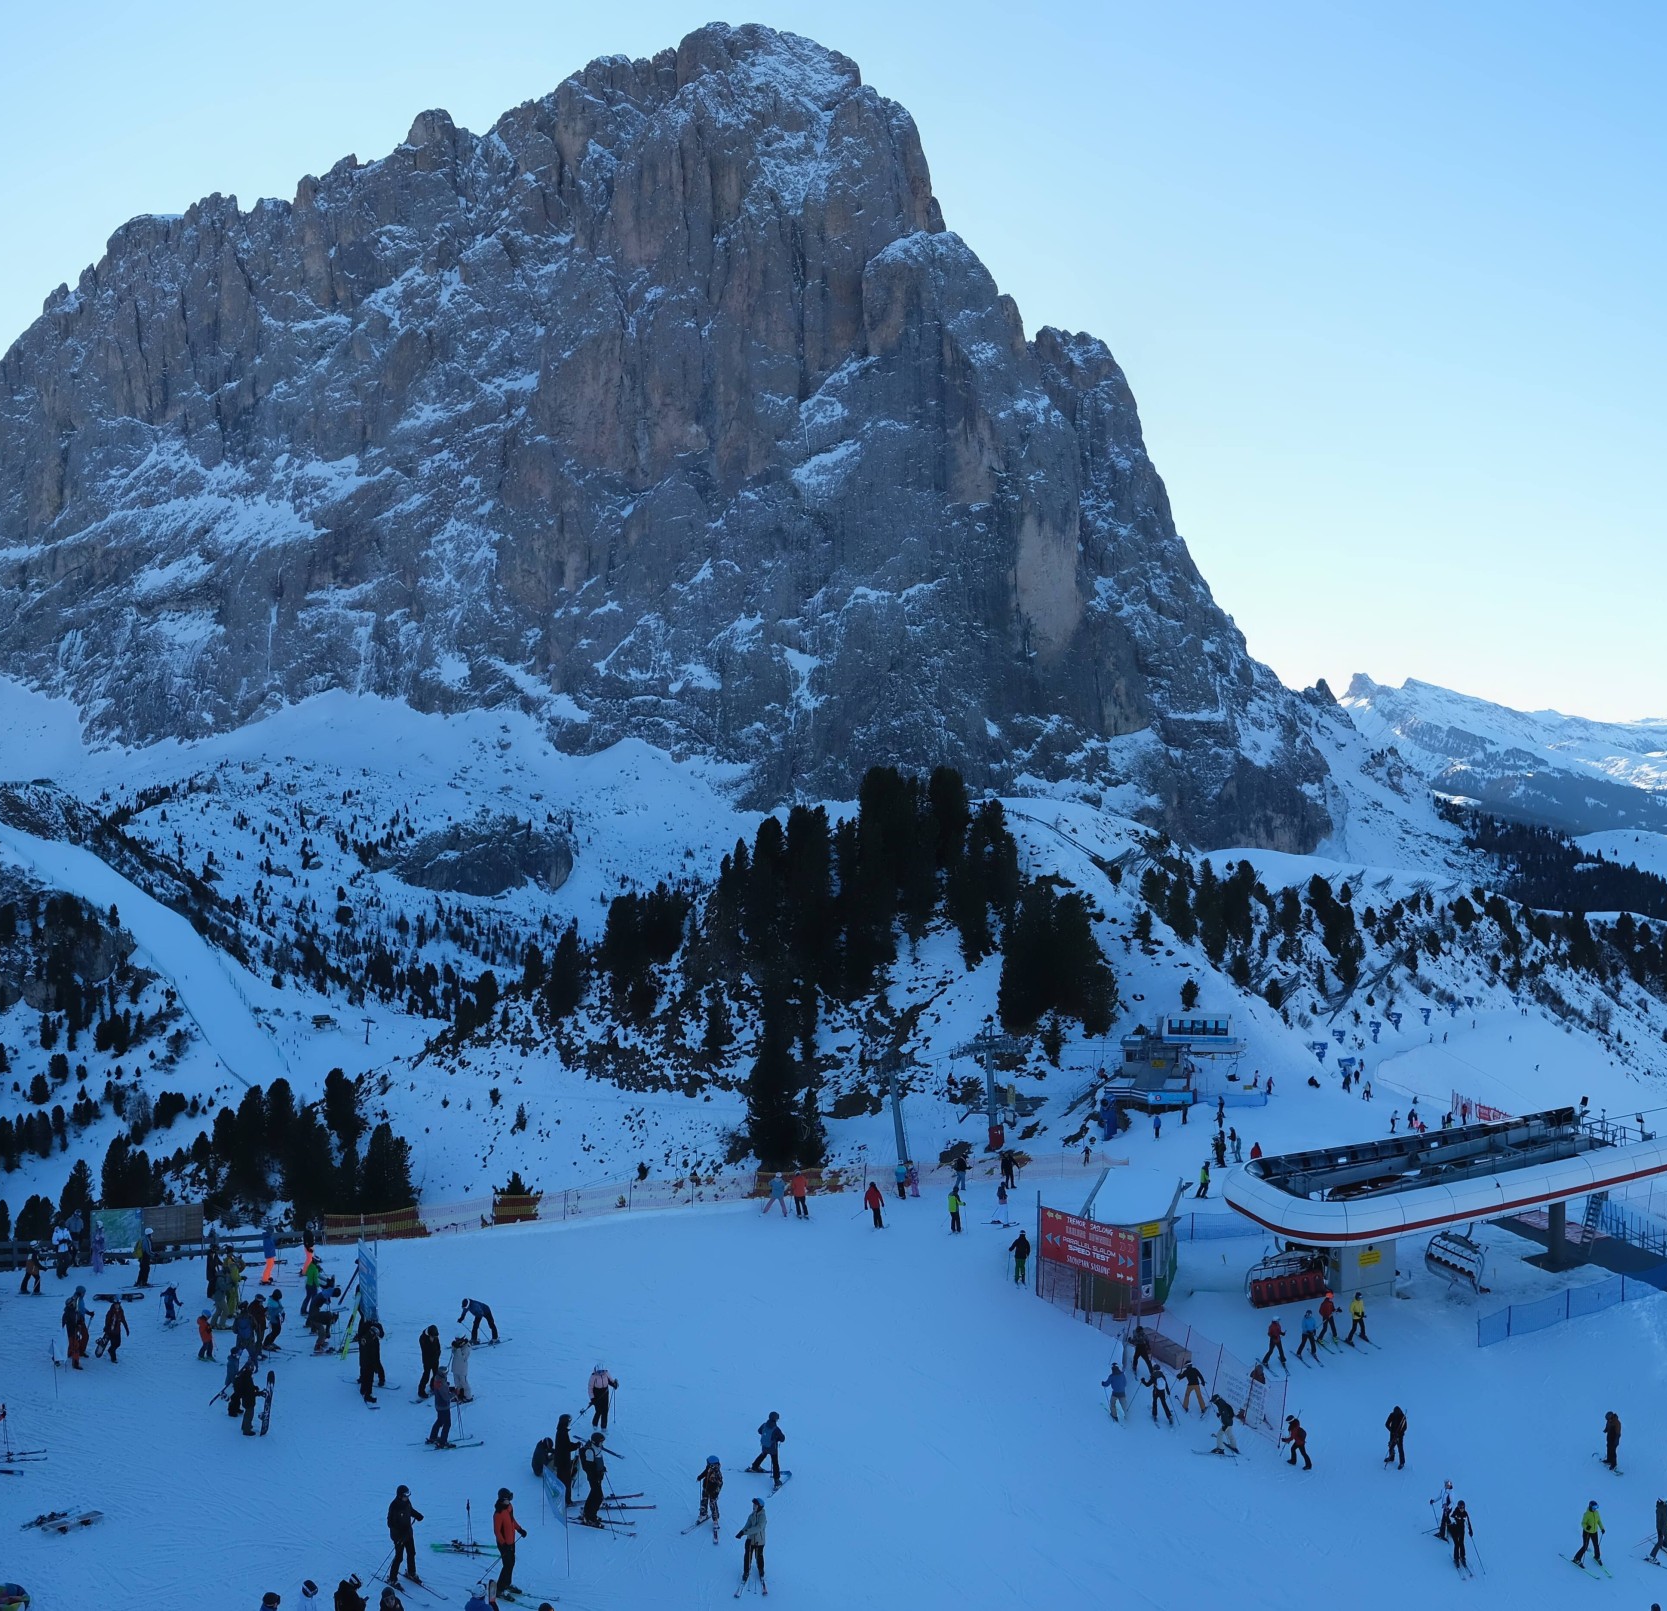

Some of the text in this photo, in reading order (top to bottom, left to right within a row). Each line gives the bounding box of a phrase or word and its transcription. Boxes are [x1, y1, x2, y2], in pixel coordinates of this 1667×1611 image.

[1066, 1216, 1086, 1228] TREMOR
[1063, 1236, 1116, 1256] PARALLEL SLALOM
[1068, 1245, 1110, 1262] SPEED TEST
